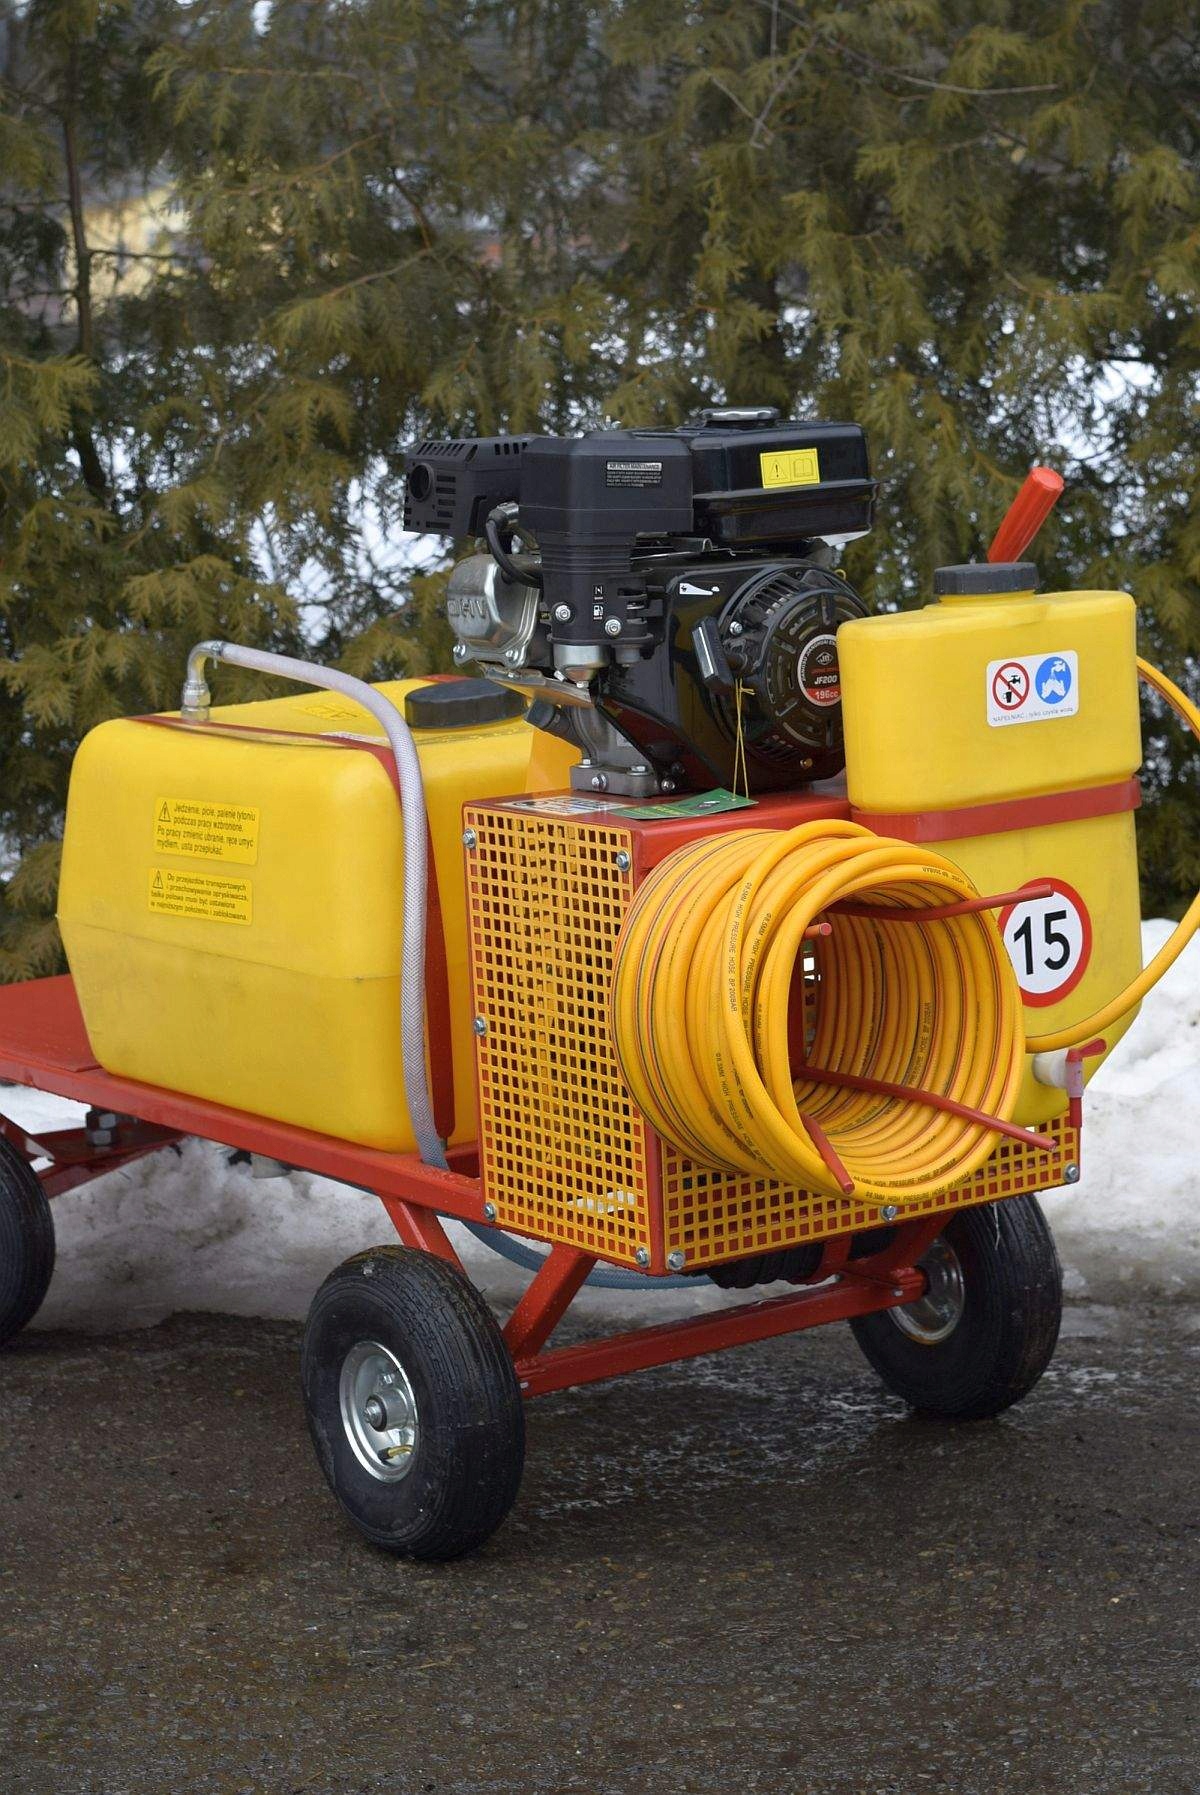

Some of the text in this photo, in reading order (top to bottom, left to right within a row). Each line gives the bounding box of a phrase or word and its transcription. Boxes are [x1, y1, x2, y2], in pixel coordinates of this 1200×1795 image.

[814, 675, 838, 685] JF200
[815, 690, 839, 700] 196cc
[729, 920, 740, 953] PRESSURE
[1013, 909, 1071, 976] 15
[728, 956, 736, 974] HOSE
